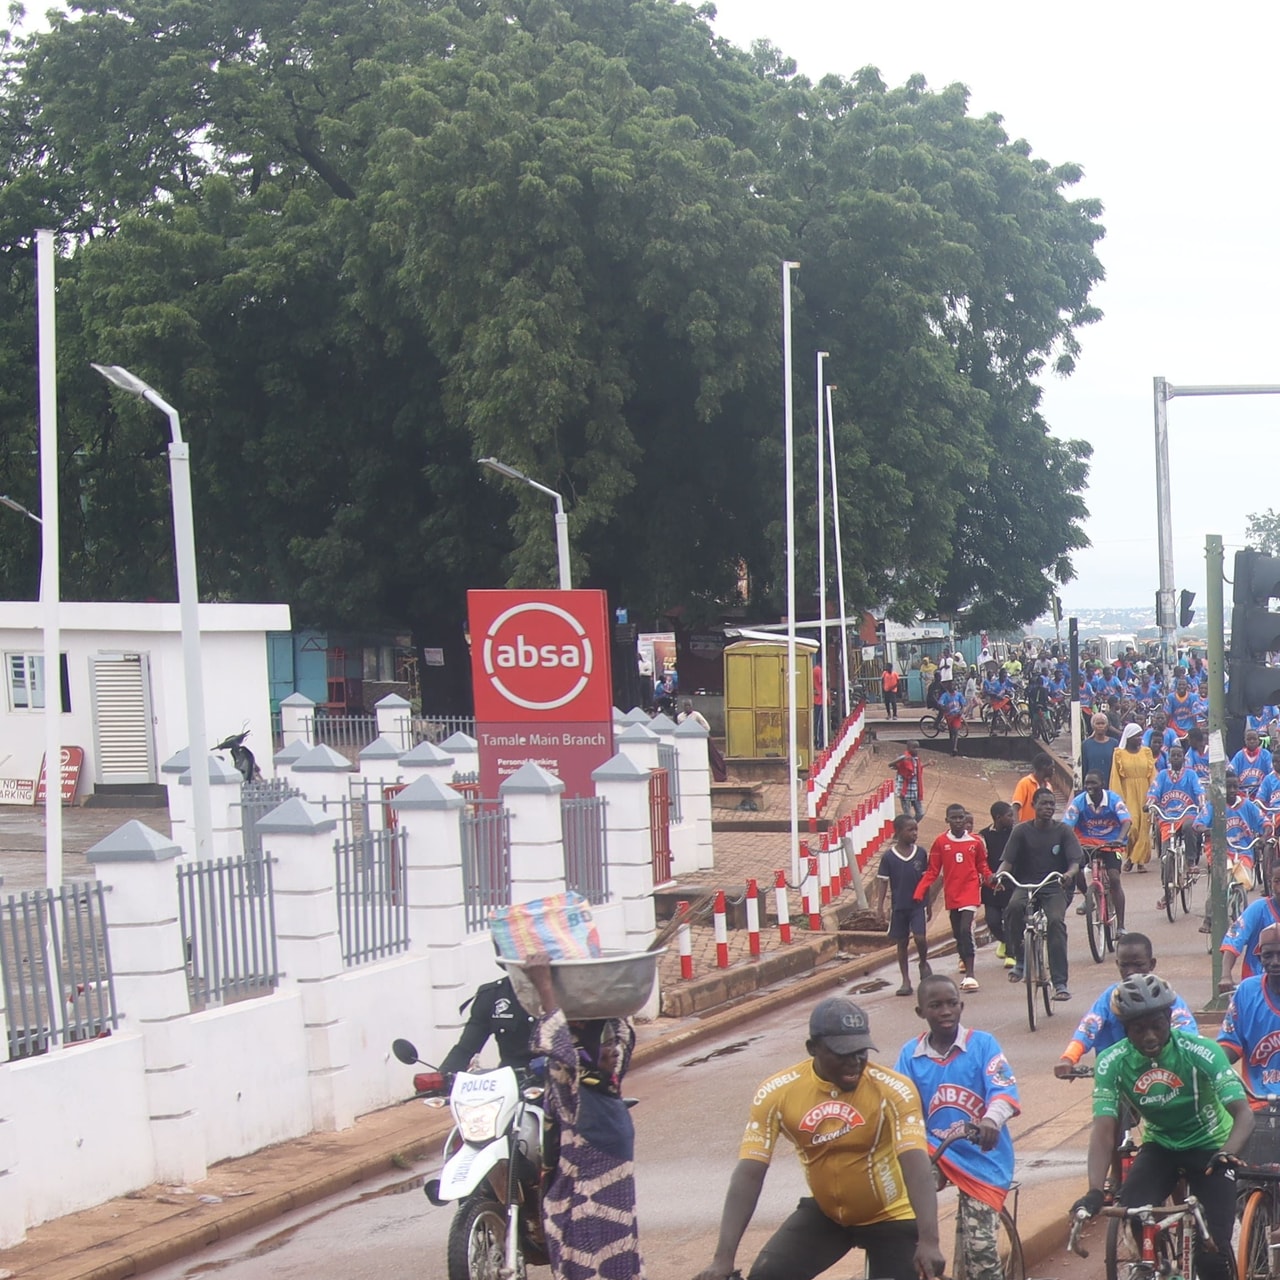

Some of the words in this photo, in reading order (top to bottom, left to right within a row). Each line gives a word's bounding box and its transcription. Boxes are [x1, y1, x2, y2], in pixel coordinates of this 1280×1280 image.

[497, 635, 579, 668] absa
[482, 733, 526, 745] Tamale
[530, 733, 559, 745] Main
[563, 733, 606, 745] Branch
[955, 852, 963, 863] 6
[1177, 1037, 1216, 1064] COWBELL
[753, 1071, 800, 1106] COWBELL
[868, 1068, 915, 1103] COWBELL
[805, 1105, 855, 1127] COWBELL
